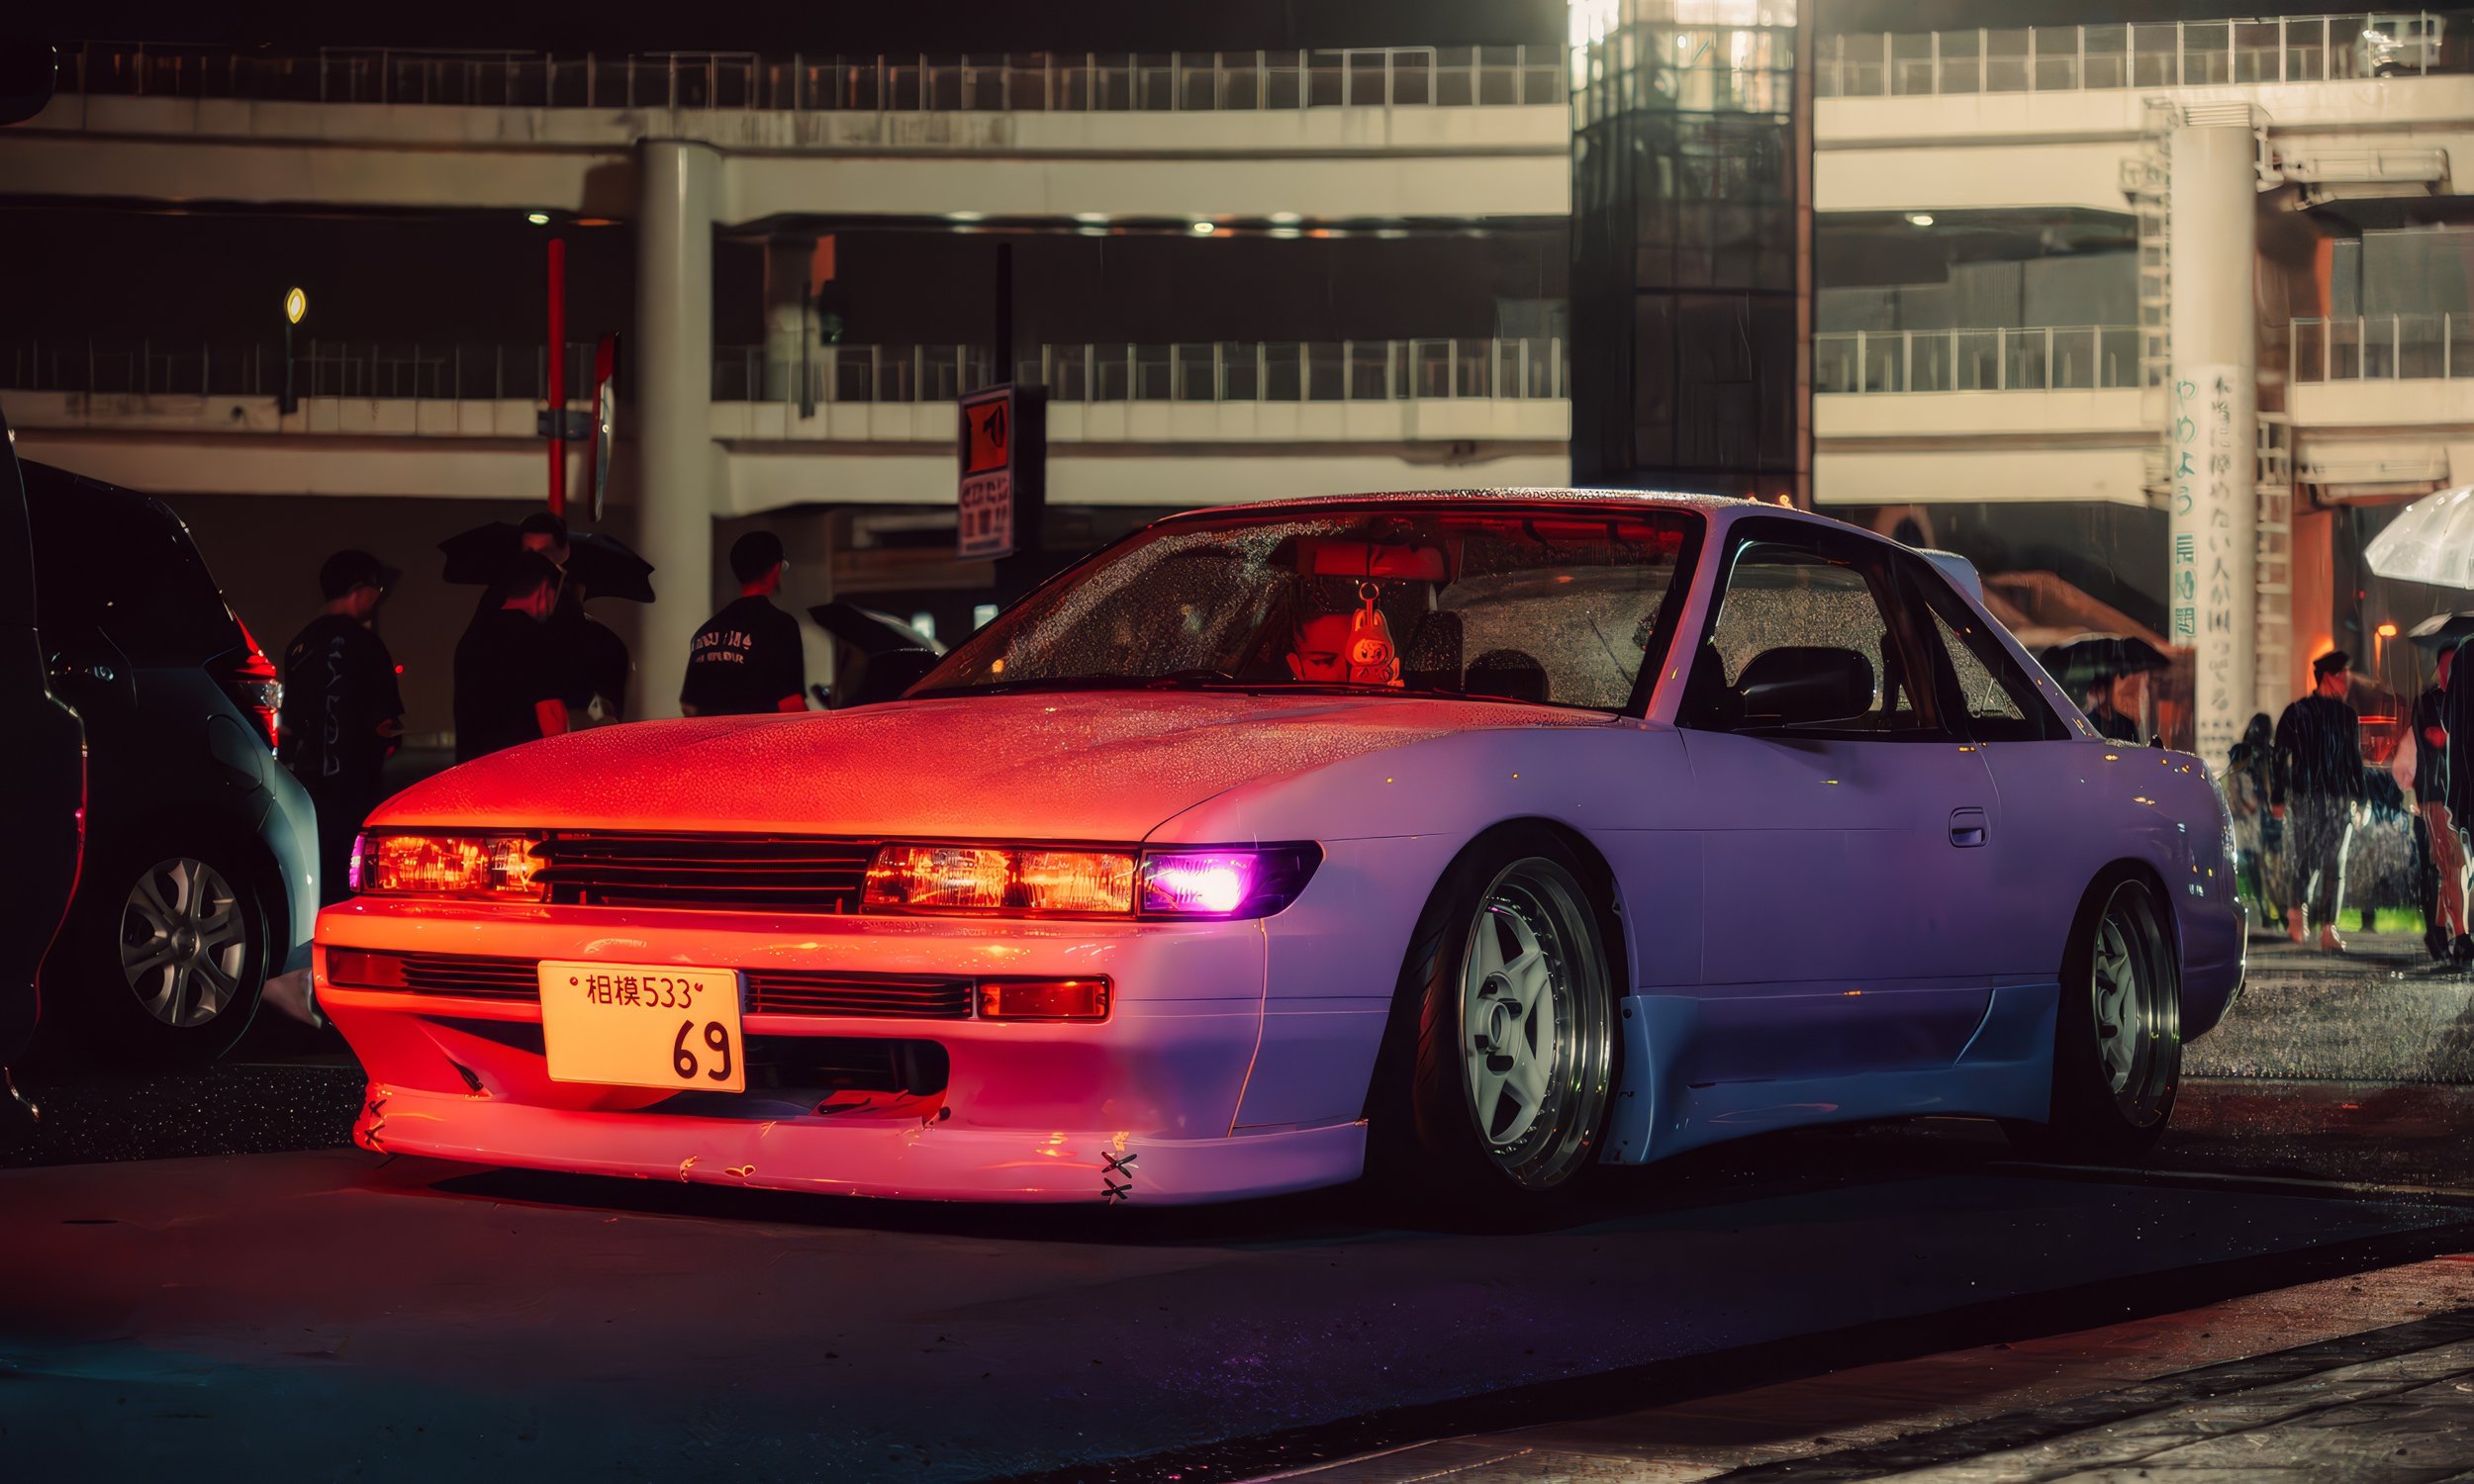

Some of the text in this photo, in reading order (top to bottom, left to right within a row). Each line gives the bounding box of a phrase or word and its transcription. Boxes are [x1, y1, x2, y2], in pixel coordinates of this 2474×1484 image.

[2176, 380, 2196, 516] やめよう
[585, 974, 693, 1009] 相模533
[673, 1019, 732, 1081] 69
